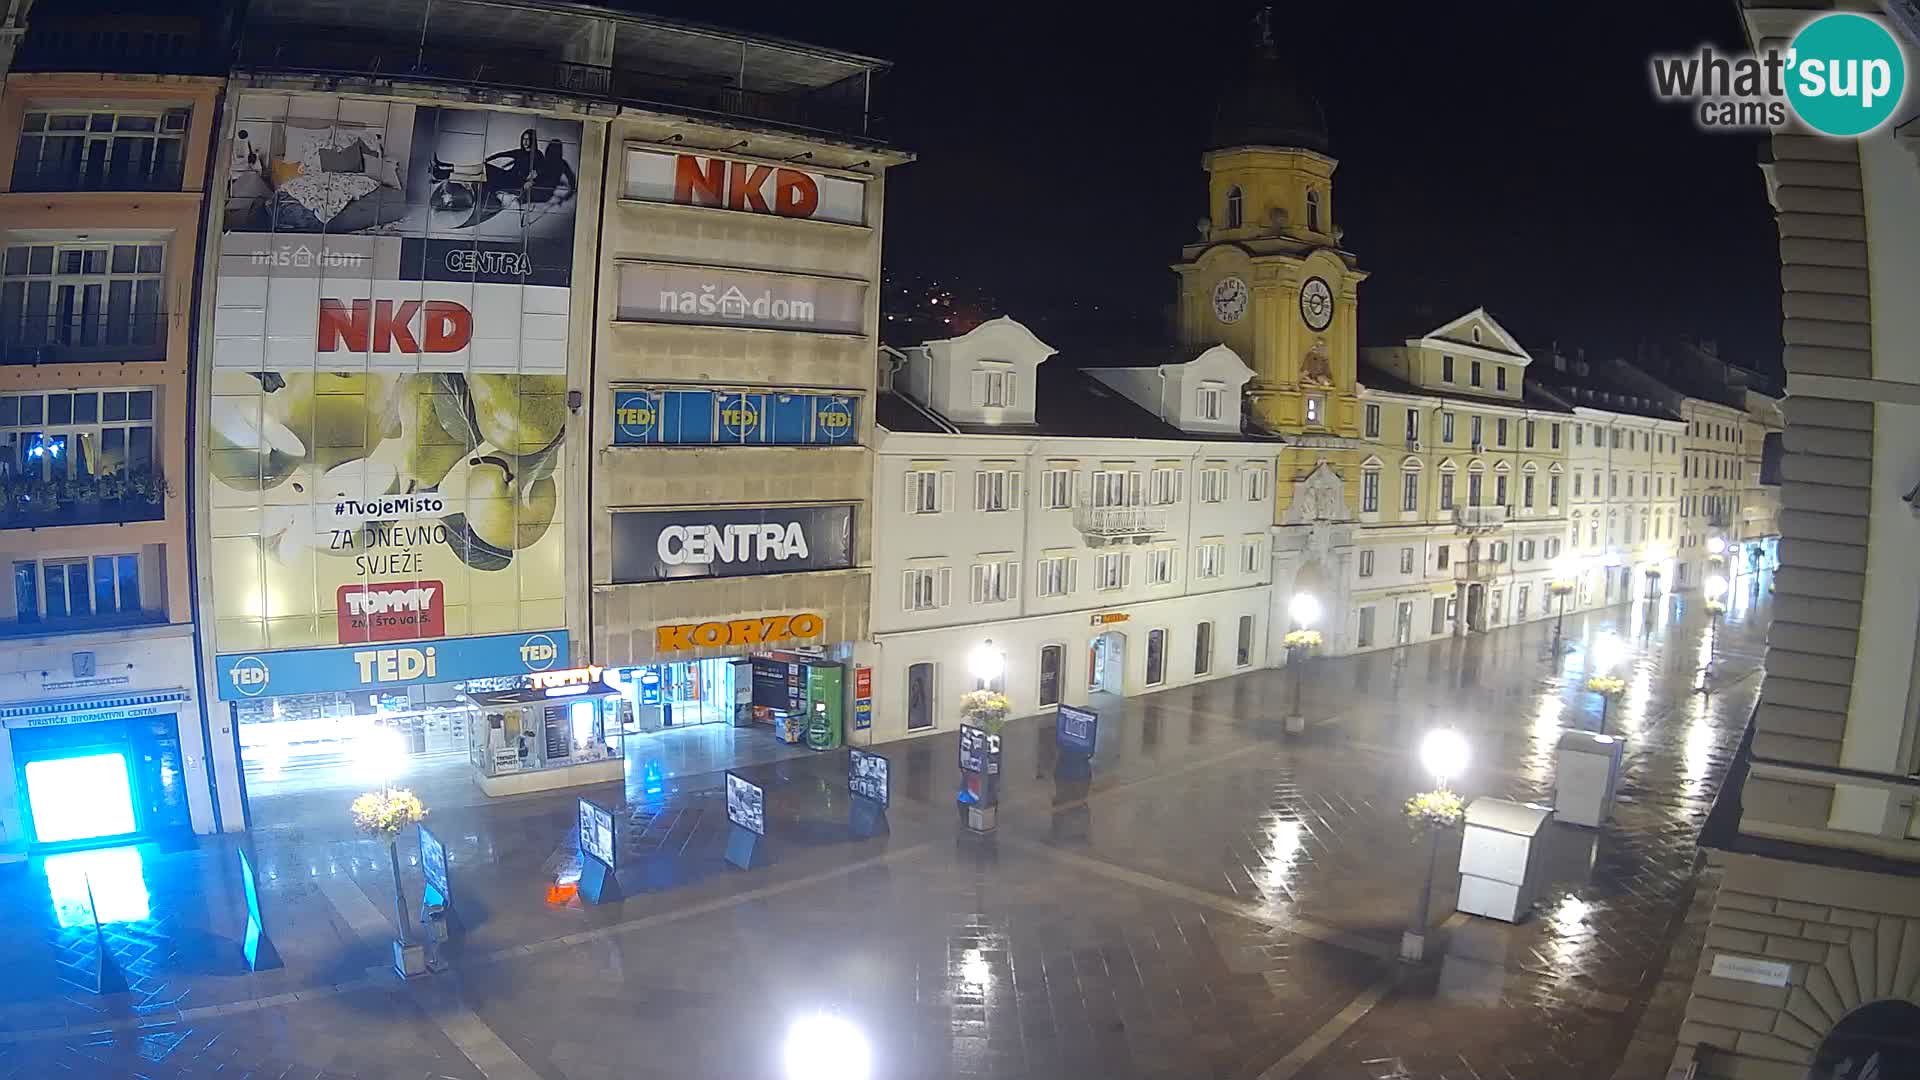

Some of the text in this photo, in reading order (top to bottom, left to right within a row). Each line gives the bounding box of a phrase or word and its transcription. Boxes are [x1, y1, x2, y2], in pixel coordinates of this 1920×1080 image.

[674, 154, 819, 217] NKD
[251, 246, 362, 268] naš dom
[445, 249, 532, 275] CENTRA
[659, 284, 815, 322] naš dom
[317, 298, 474, 353] NKD
[616, 408, 656, 426] TEDi
[721, 409, 758, 427] TEDi
[818, 411, 851, 427] TEDi
[335, 498, 443, 516] #TvojeMisto
[330, 524, 448, 550] ZA DNEVNO
[657, 521, 809, 565] CENTRA
[355, 548, 424, 576] SVJEŽE
[345, 587, 436, 615] TOMMY
[376, 615, 397, 626] ŠTO
[656, 613, 824, 652] KORZO
[355, 647, 436, 683] TEDi
[520, 644, 558, 662] TEDi
[230, 667, 269, 686] TEDi
